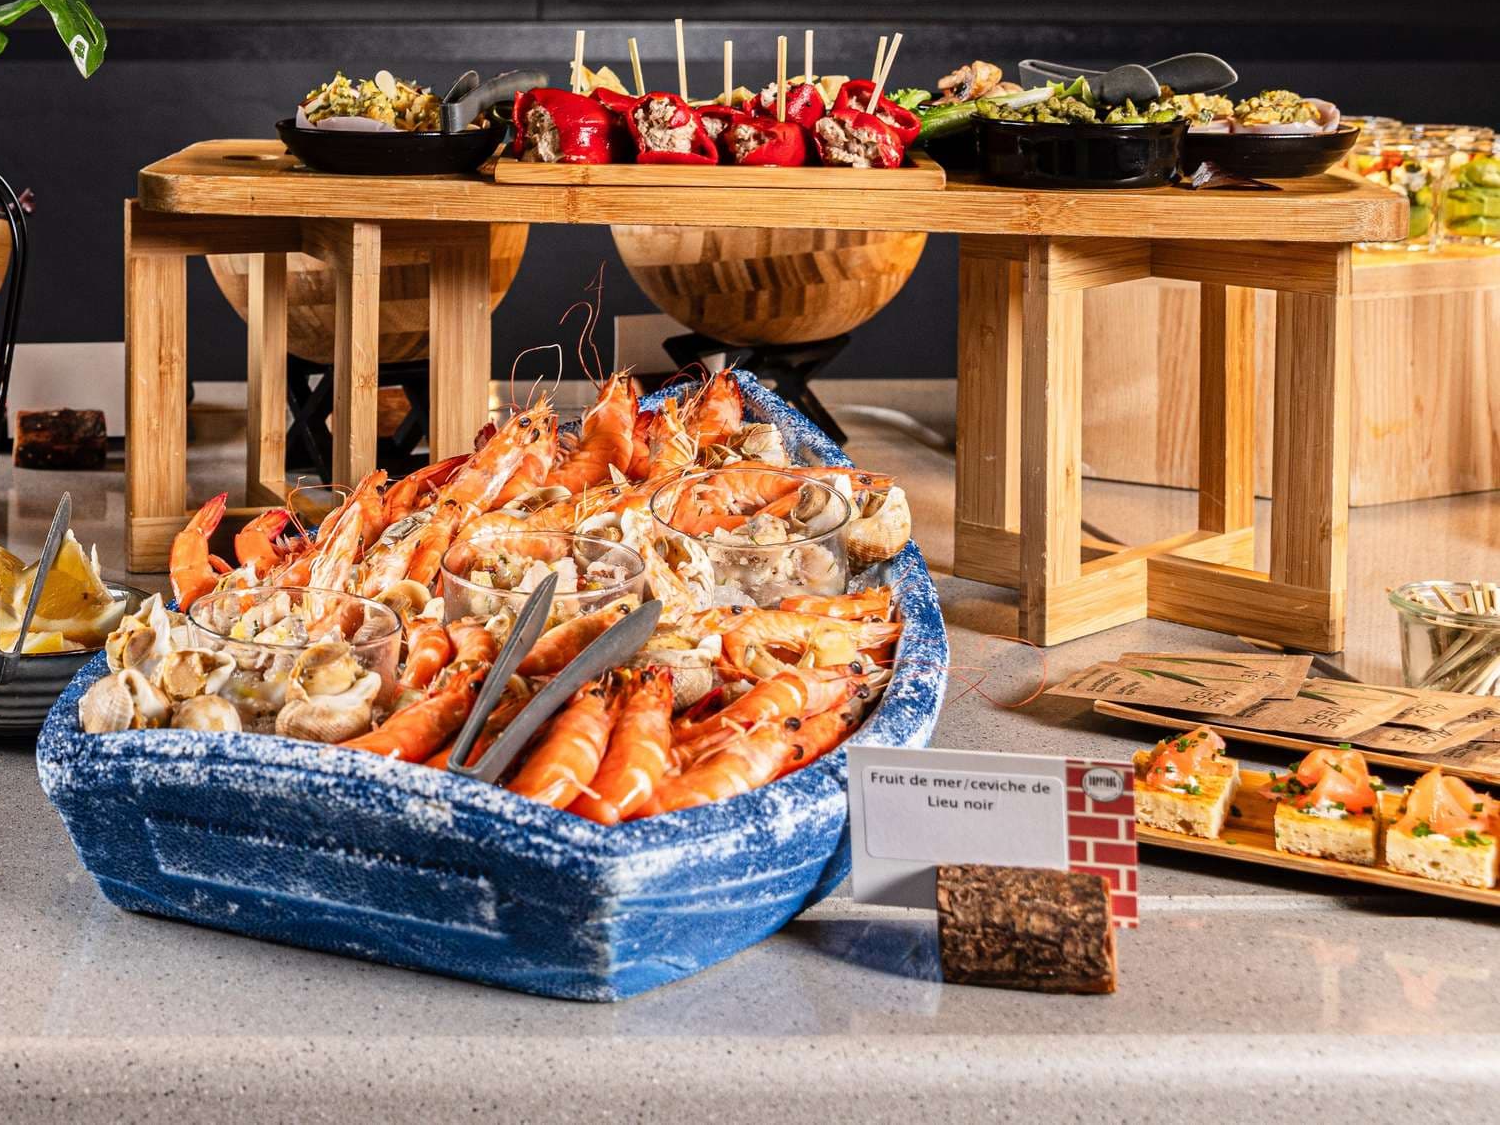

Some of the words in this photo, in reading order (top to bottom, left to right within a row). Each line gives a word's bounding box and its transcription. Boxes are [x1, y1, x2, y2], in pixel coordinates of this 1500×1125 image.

[1318, 708, 1365, 730] ALOE
[871, 772, 904, 785] Fruit
[910, 775, 928, 787] de
[1032, 782, 1051, 794] de
[928, 796, 958, 809] Lieu
[964, 798, 994, 811] noir
